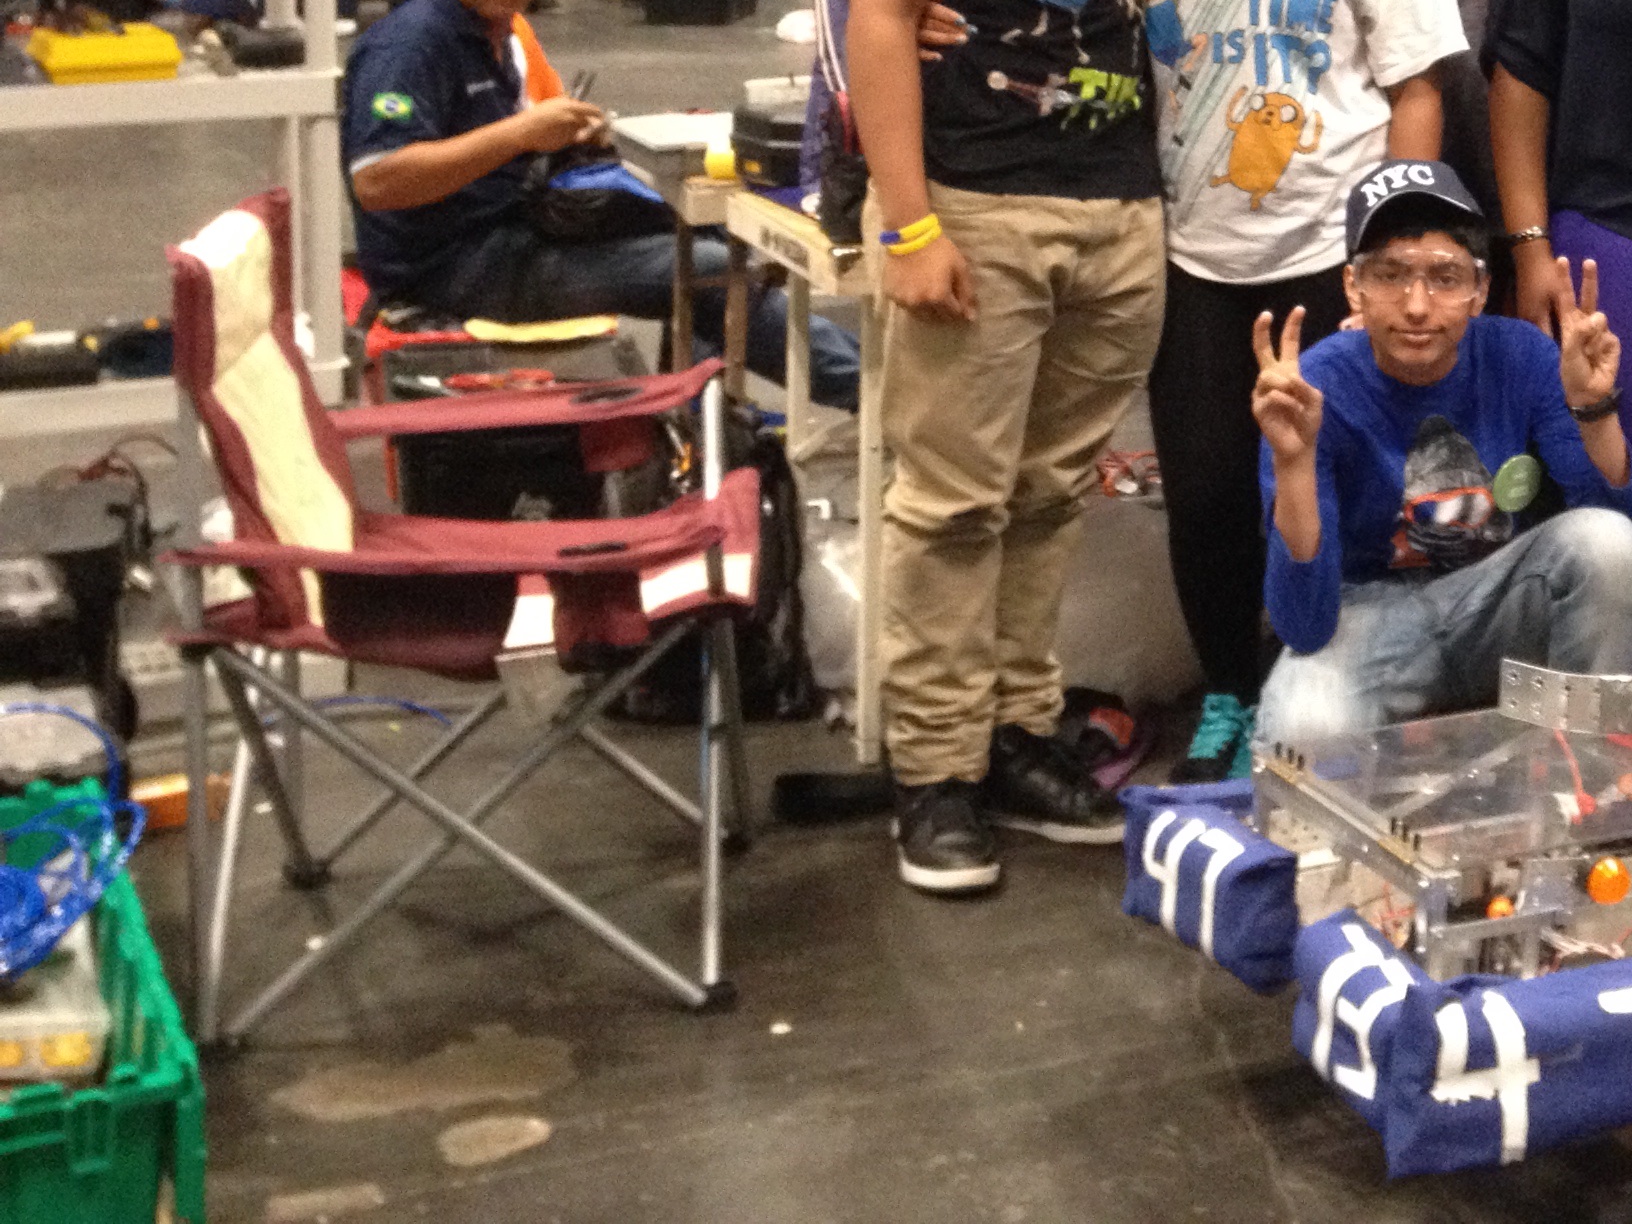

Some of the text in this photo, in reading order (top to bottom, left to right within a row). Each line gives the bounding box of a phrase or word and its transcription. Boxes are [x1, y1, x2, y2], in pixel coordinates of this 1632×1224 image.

[1213, 29, 1331, 95] IS IT?
[1361, 164, 1435, 207] NYC
[1144, 811, 1243, 958] 47
